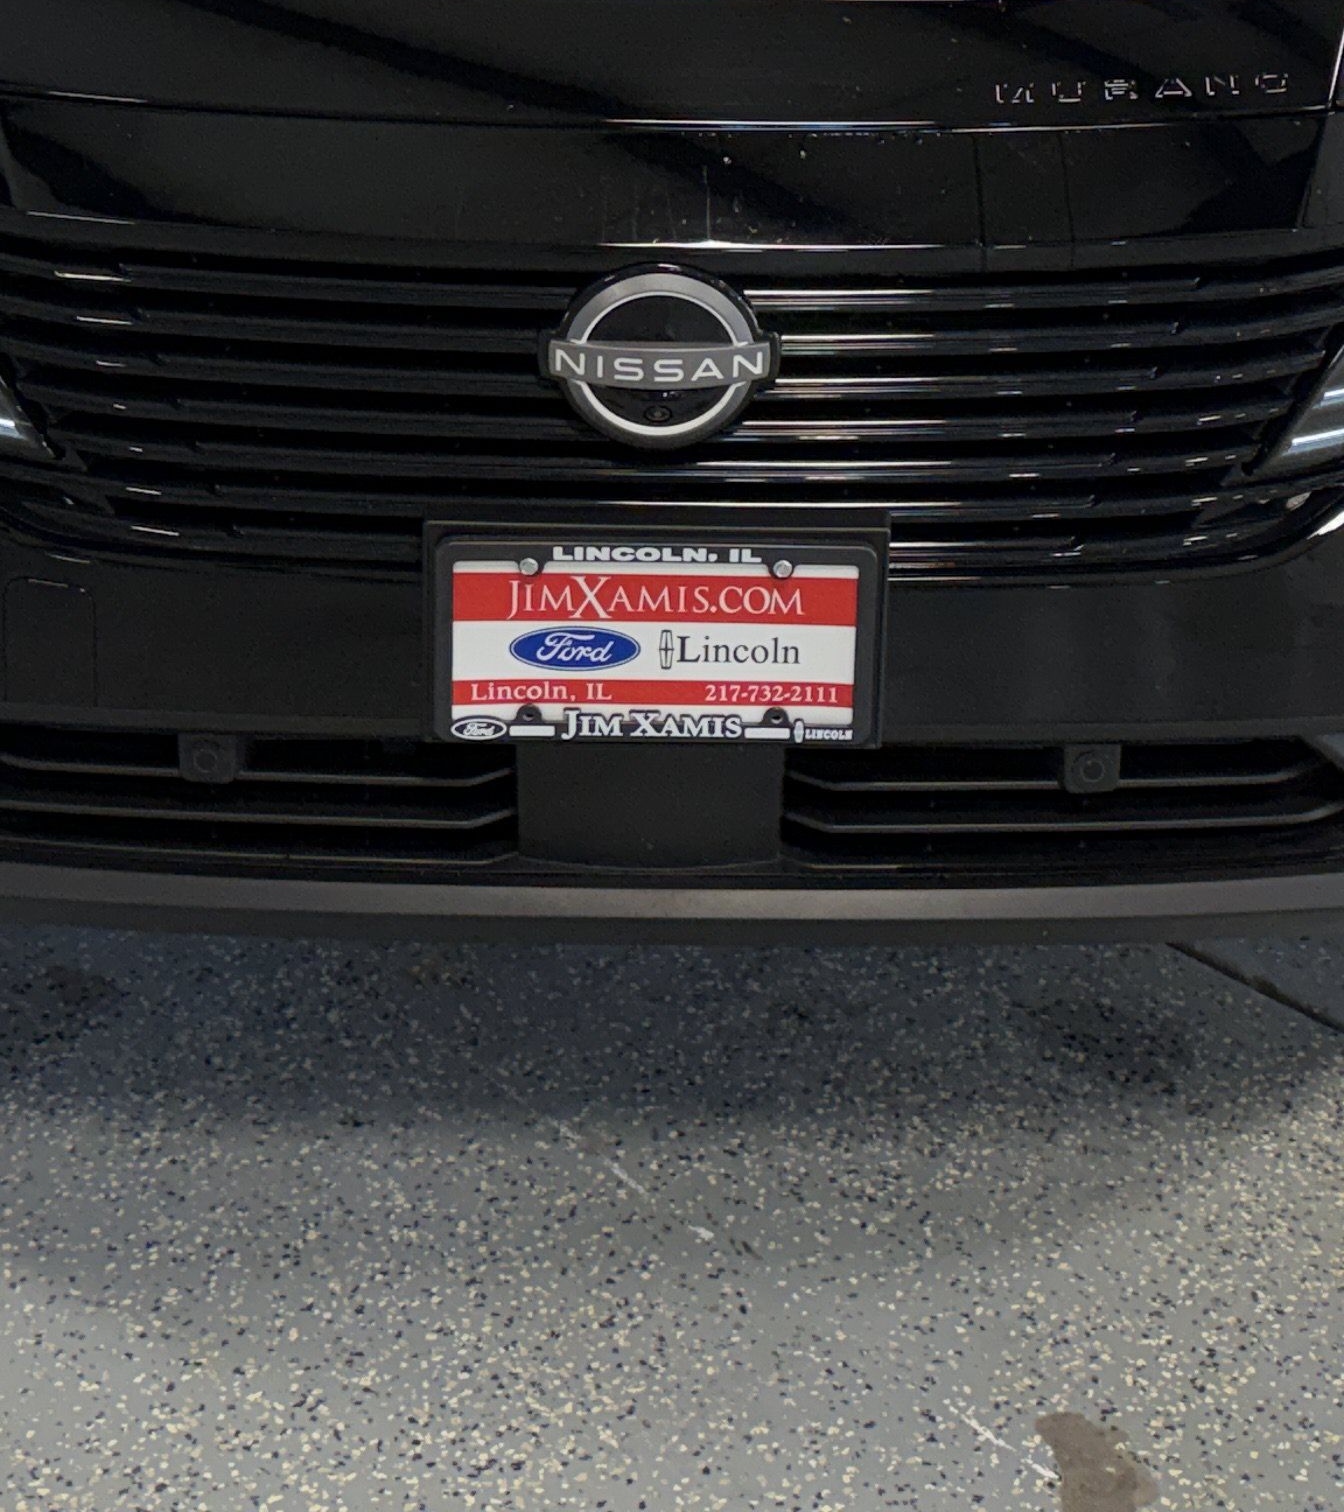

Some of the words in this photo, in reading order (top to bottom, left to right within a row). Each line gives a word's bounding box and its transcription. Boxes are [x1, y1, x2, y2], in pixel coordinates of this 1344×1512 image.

[555, 348, 763, 382] NISSAN
[729, 548, 762, 563] IL
[536, 632, 612, 663] Ford
[677, 636, 800, 664] Lincoln
[471, 682, 576, 702] Lincoln,
[587, 684, 612, 701] IL
[705, 684, 838, 703] 217-732-2111
[805, 729, 853, 740] LINCOLN
